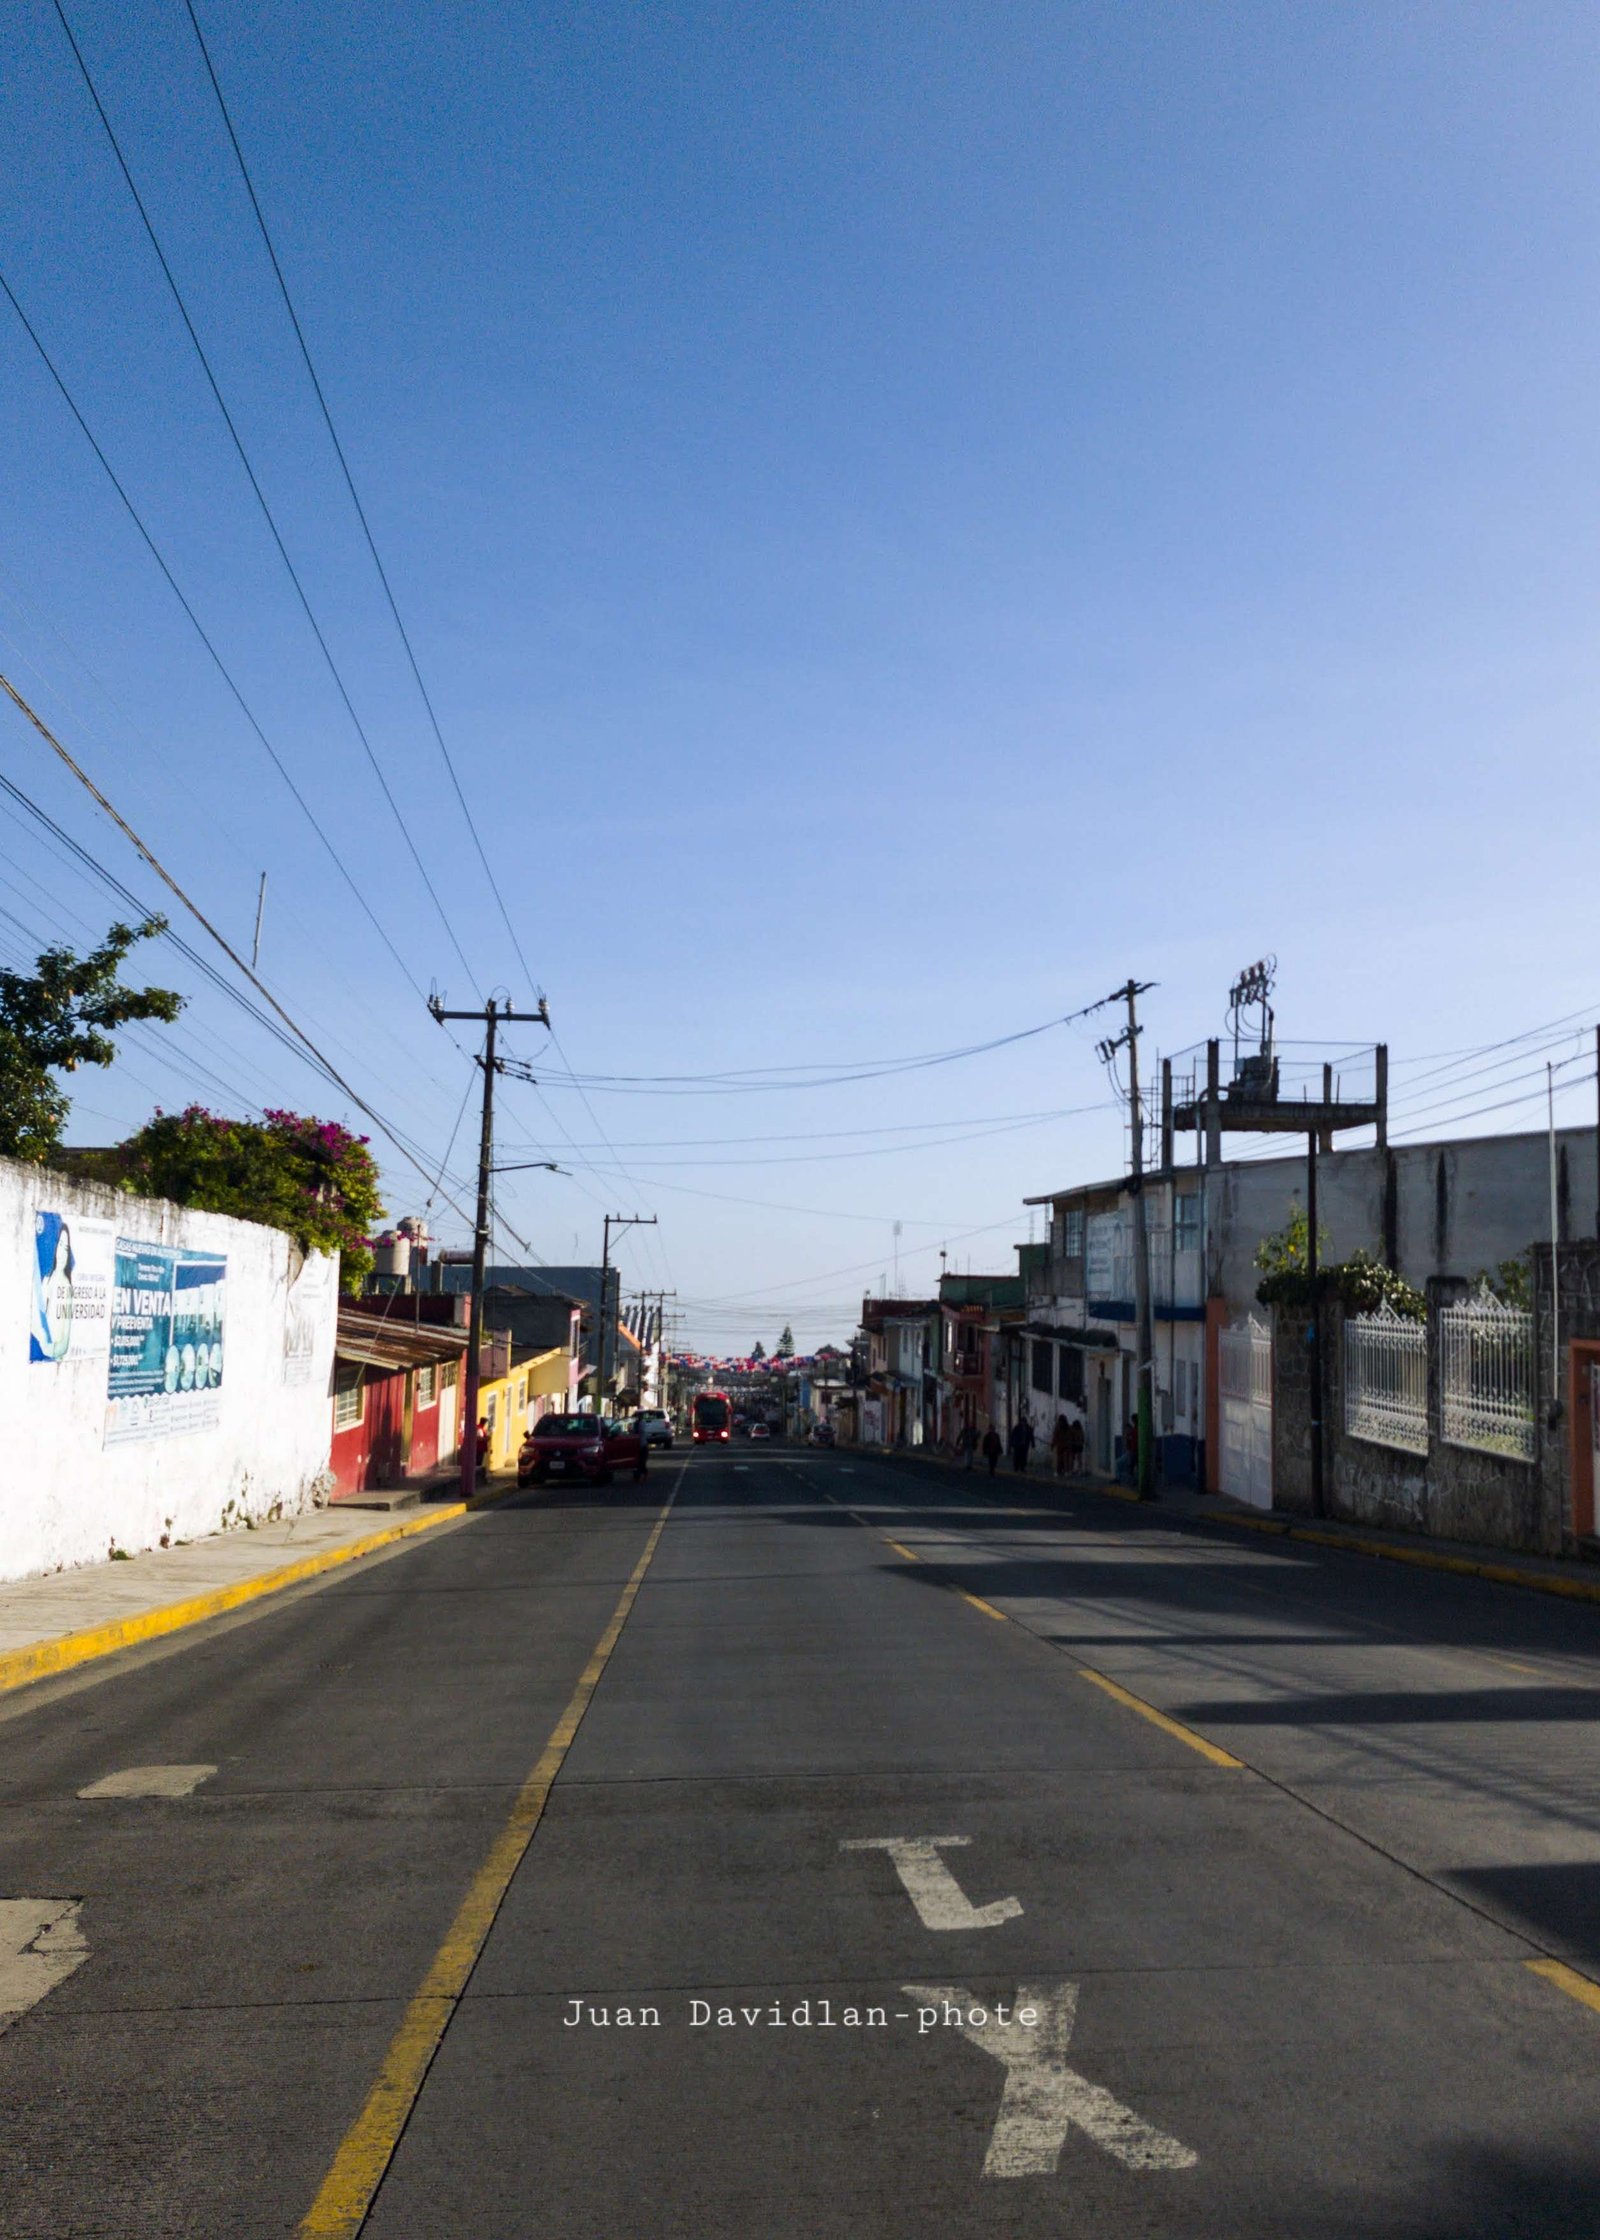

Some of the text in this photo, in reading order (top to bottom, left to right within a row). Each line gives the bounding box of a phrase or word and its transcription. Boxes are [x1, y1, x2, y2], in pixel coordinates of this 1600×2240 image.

[57, 1286, 66, 1299] DE
[99, 1287, 106, 1299] LA
[113, 1287, 171, 1316] EN VENTA
[56, 1303, 106, 1319] UNIVERSIDAD
